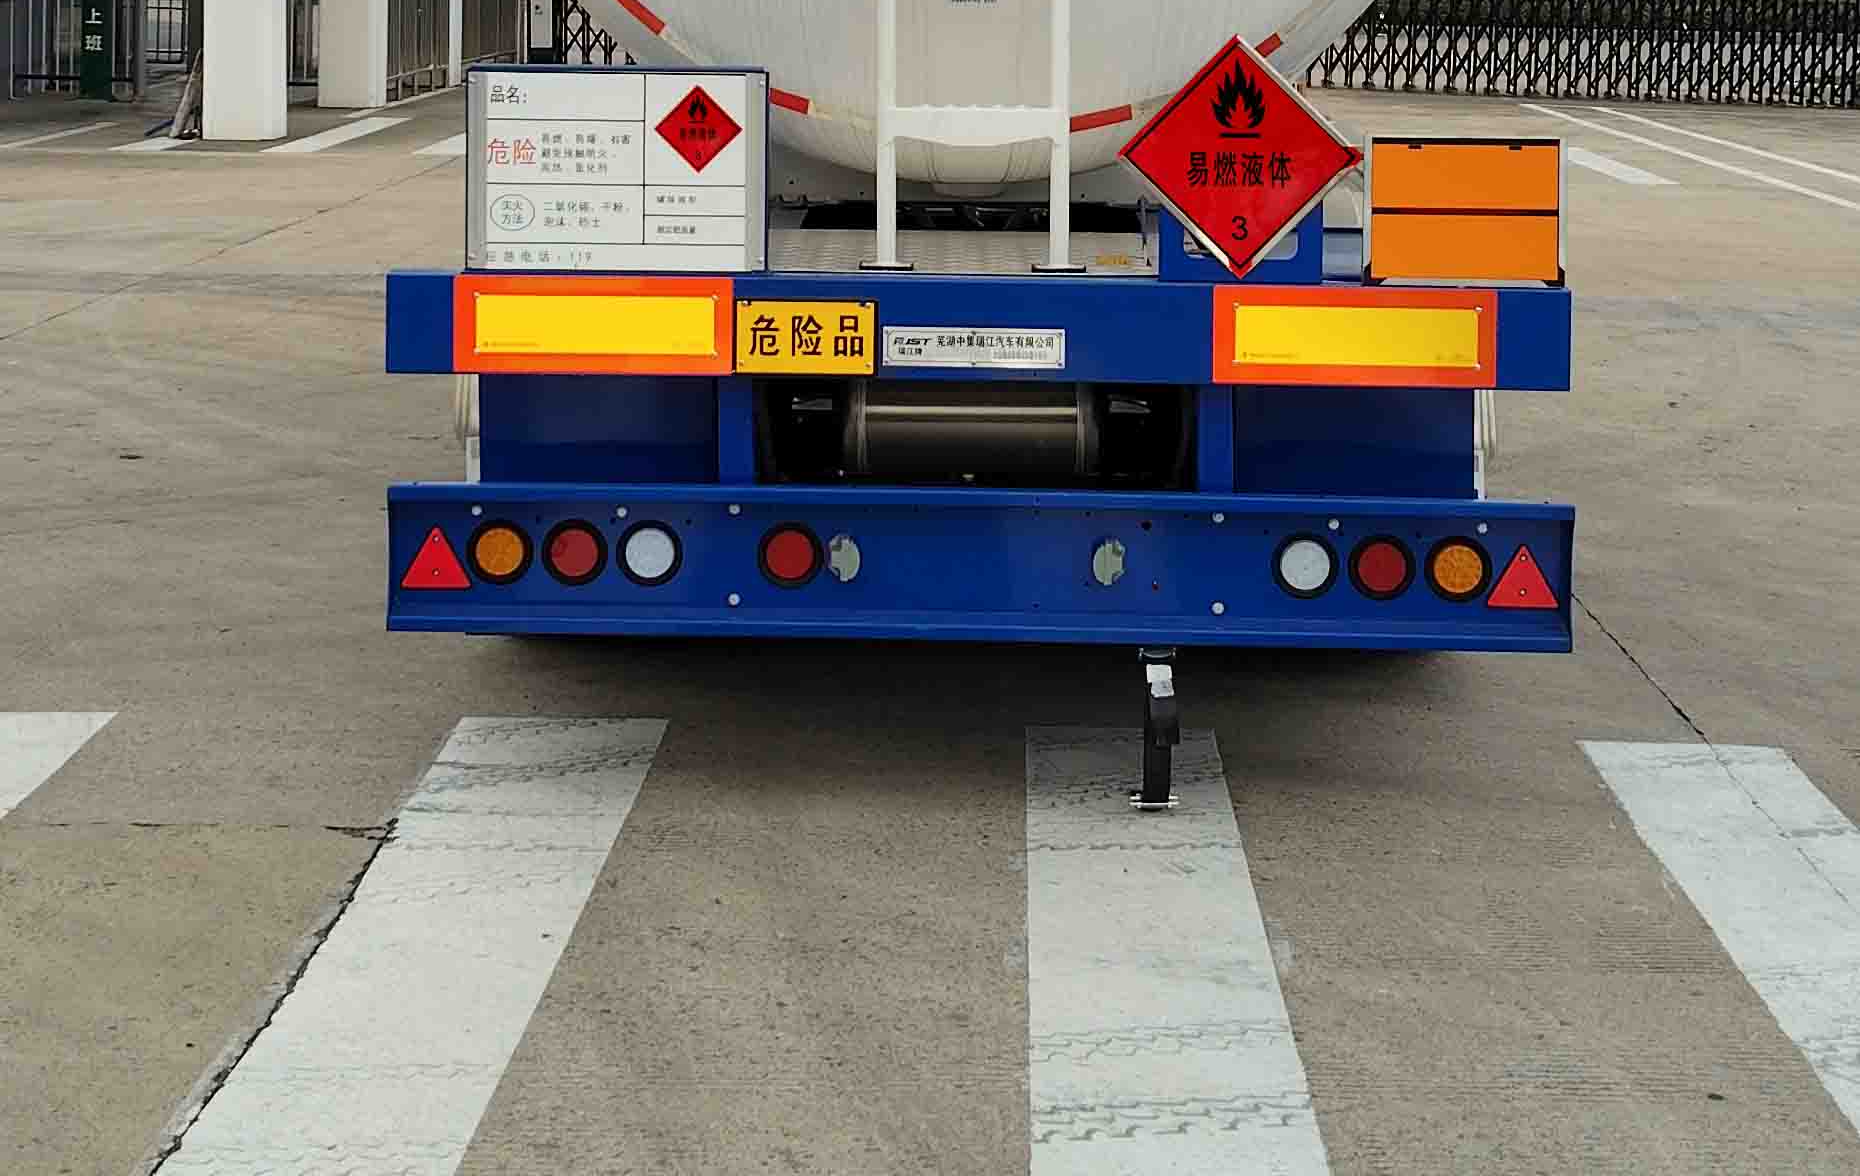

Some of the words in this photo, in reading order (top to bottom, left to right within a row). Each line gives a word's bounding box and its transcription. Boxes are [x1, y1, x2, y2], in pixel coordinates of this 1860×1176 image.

[487, 138, 537, 165] 危险
[1186, 151, 1292, 188] 易燃液体
[1231, 215, 1248, 241] 3
[749, 313, 864, 357] 危险品
